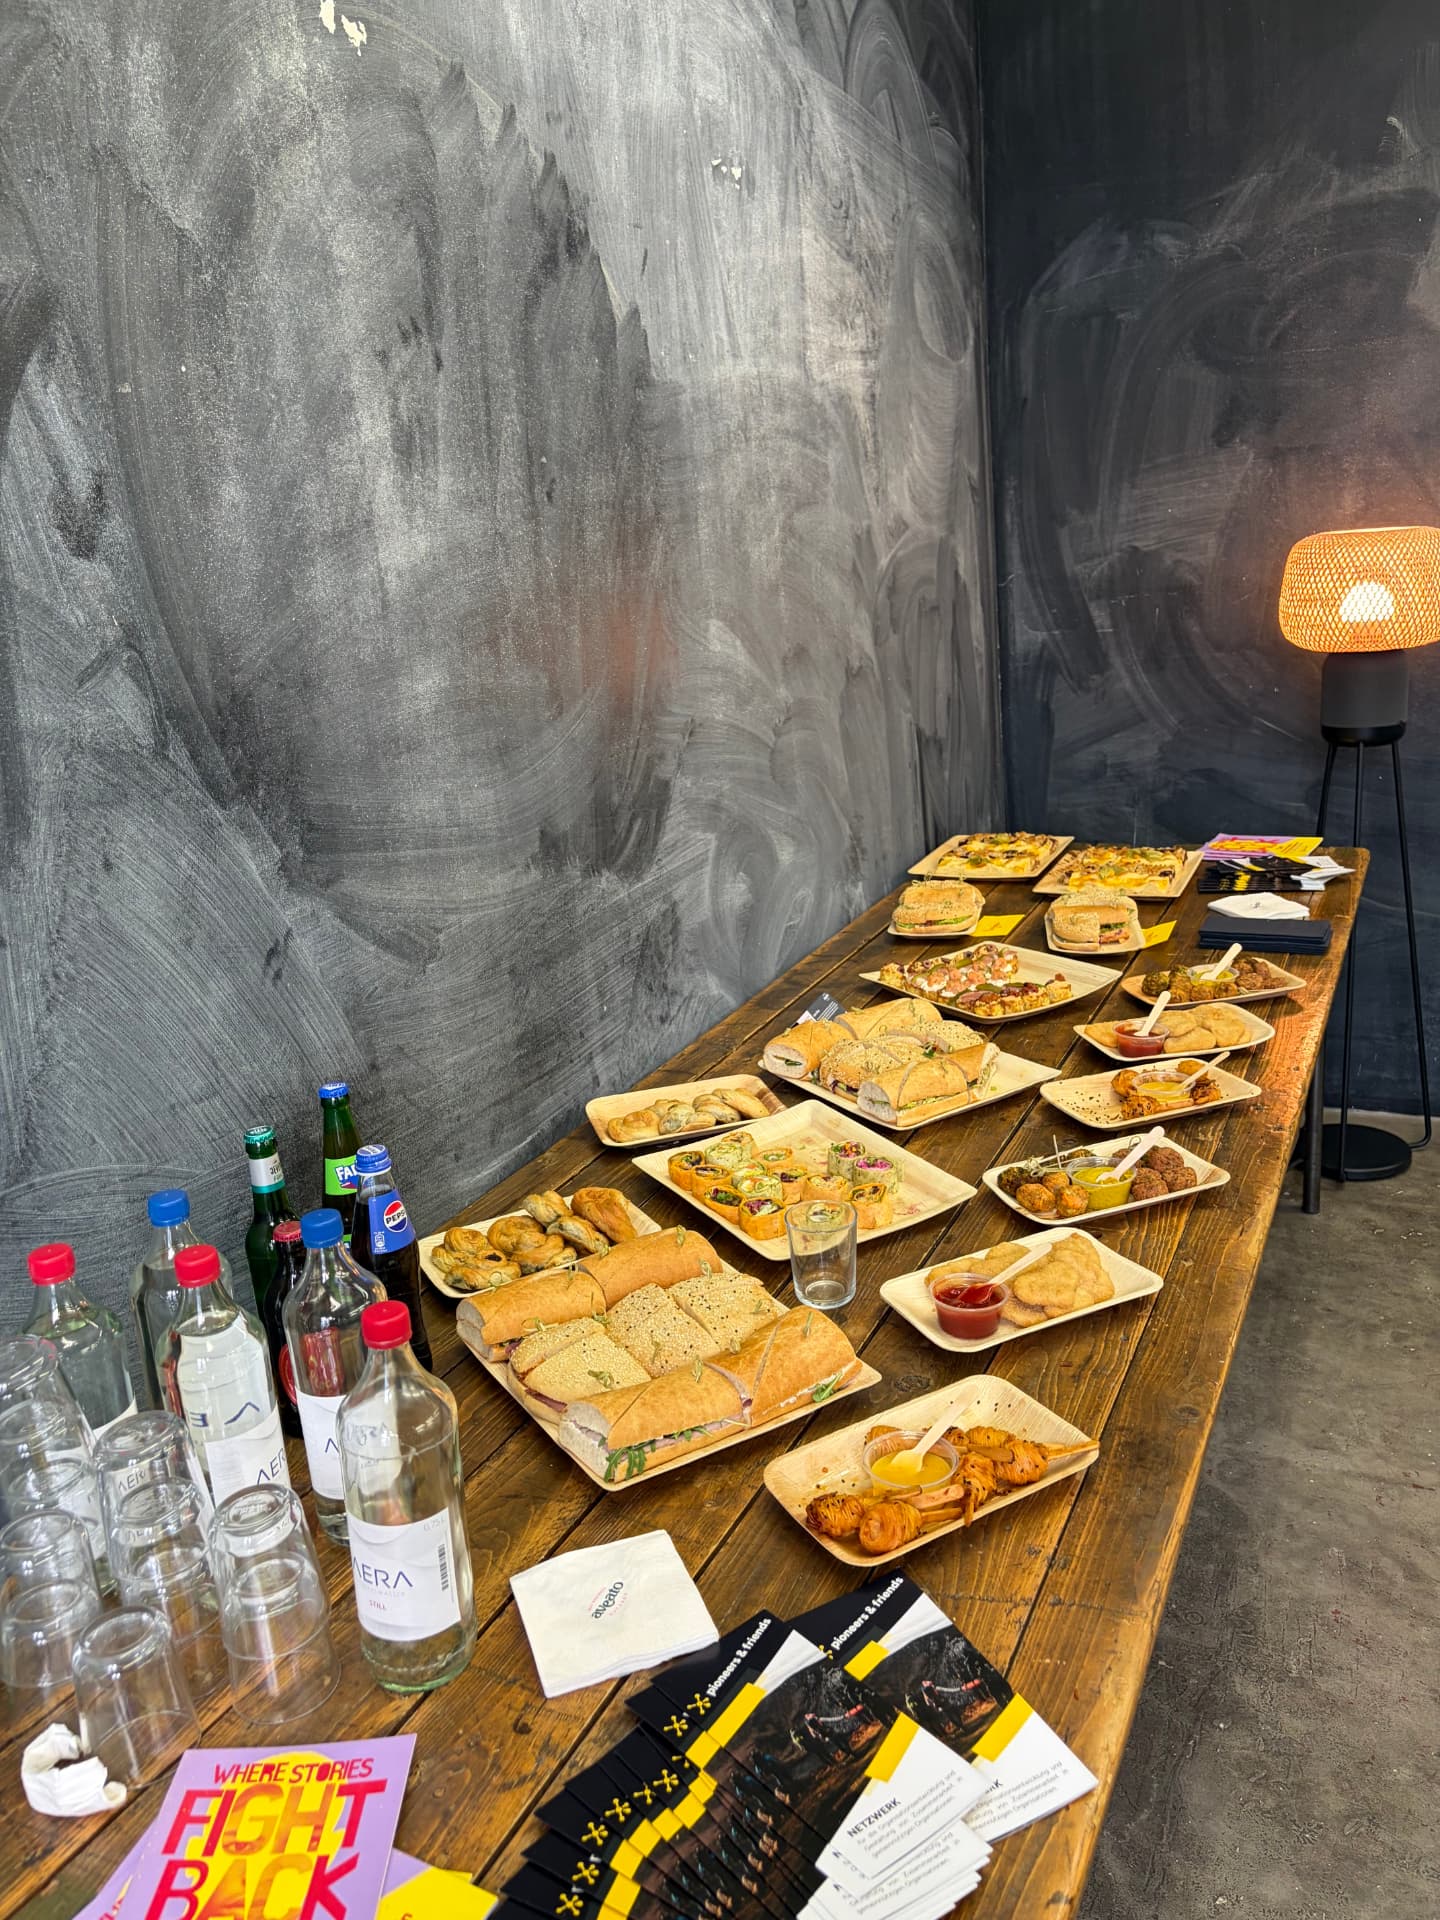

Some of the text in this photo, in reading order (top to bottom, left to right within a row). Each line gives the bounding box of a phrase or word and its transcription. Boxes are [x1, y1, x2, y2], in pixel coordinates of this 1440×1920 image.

[592, 1581, 624, 1619] aveato
[831, 1576, 904, 1650] pioneers & friends
[706, 1617, 772, 1697] pioneers & friends
[213, 1758, 374, 1784] WHERE STORIES
[161, 1779, 388, 1857] FIGHT
[847, 1797, 902, 1837] NETZWERK
[144, 1852, 360, 1920] BACK
